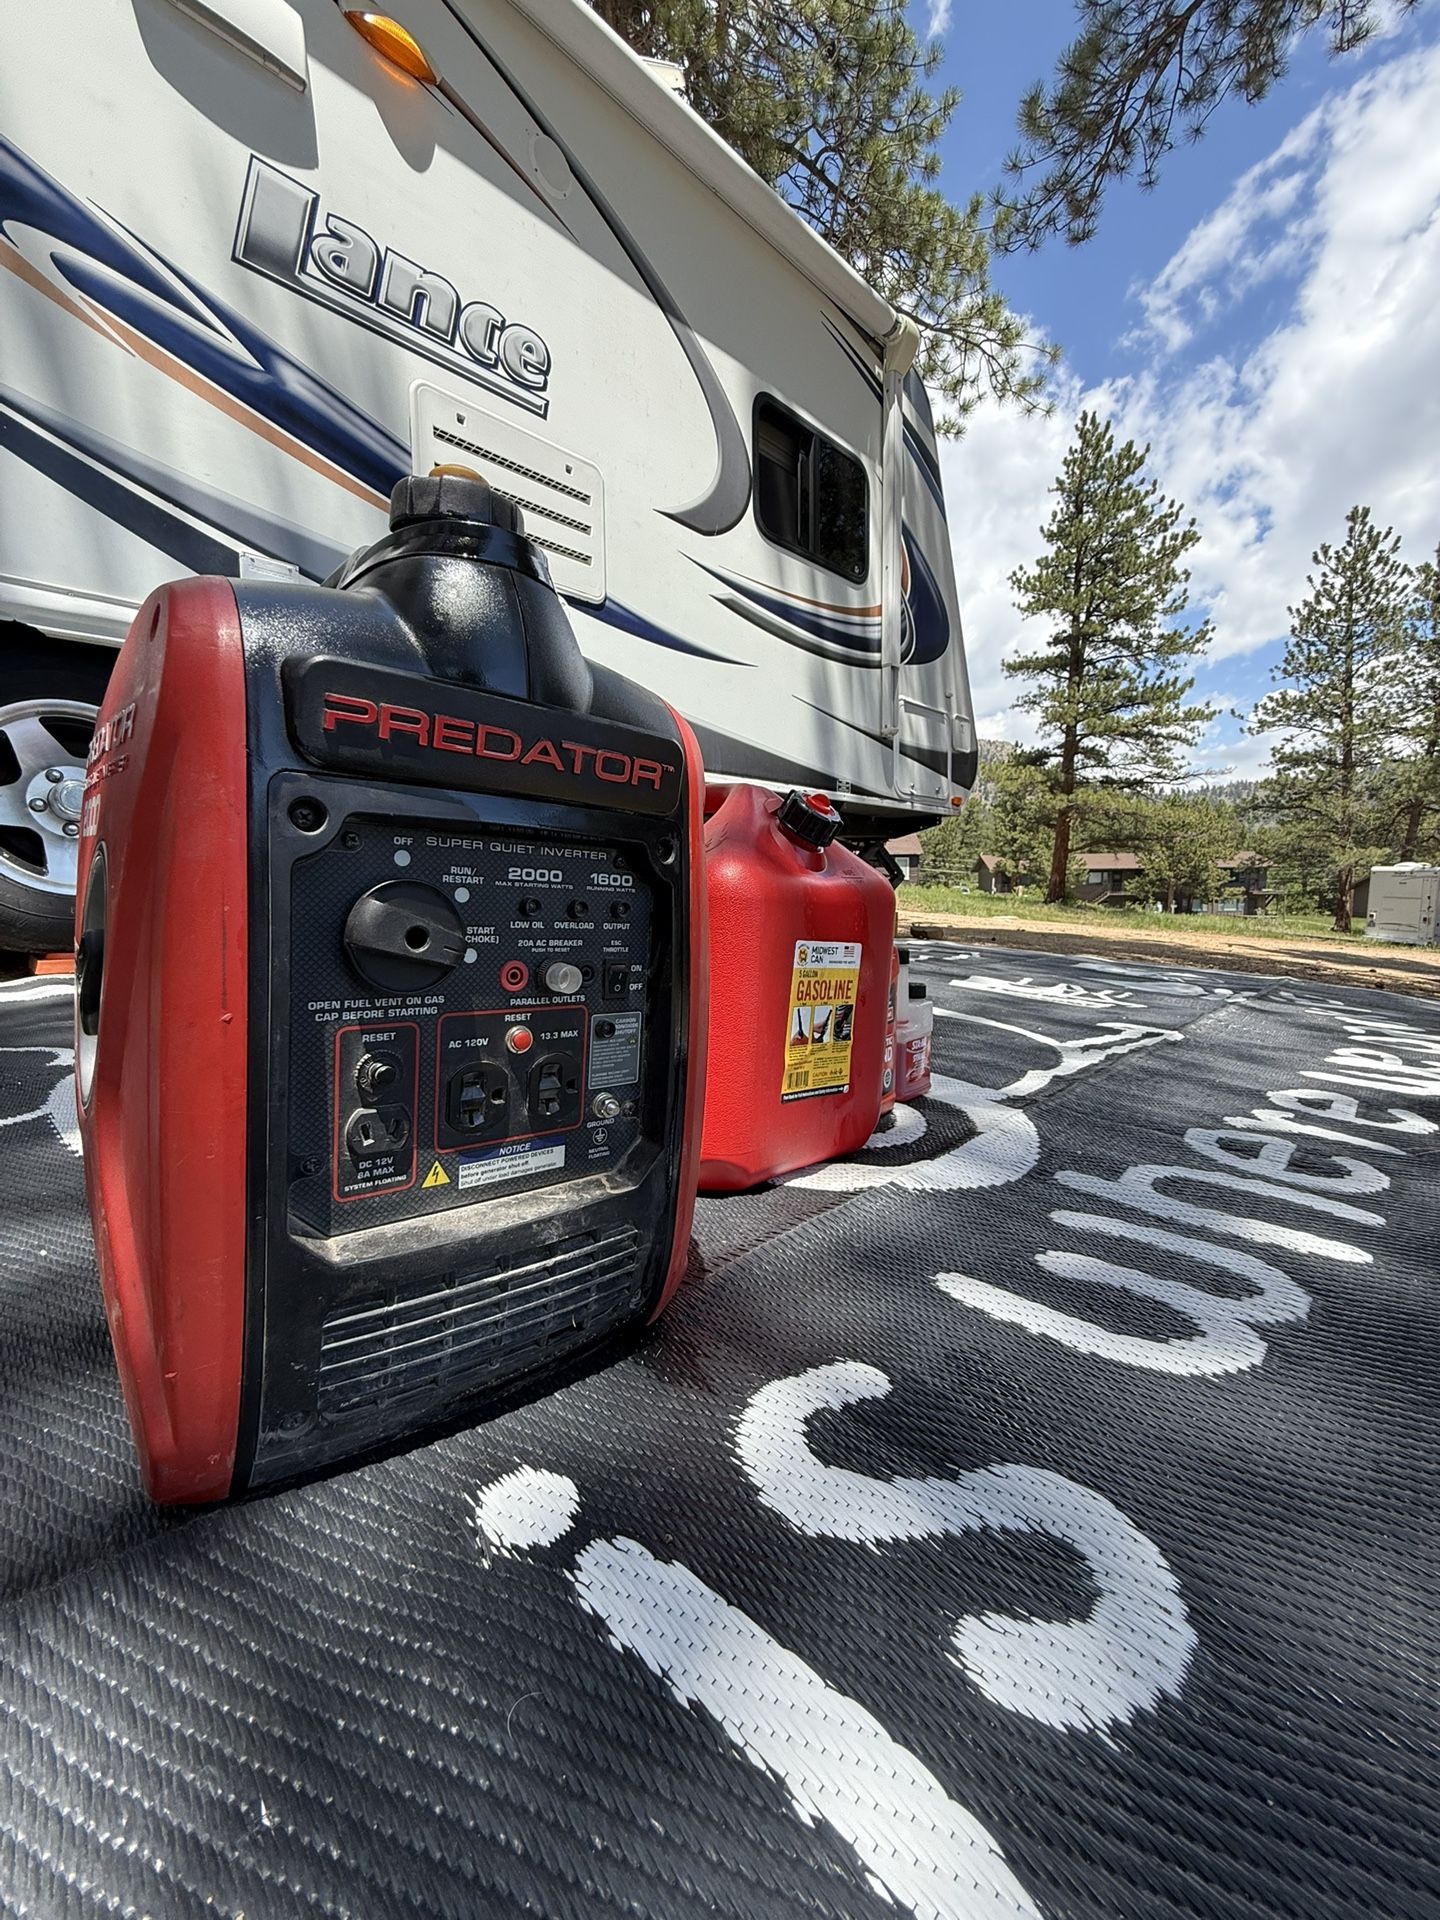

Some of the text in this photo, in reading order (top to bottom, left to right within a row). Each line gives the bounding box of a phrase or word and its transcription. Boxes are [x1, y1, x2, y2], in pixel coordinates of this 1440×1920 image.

[323, 692, 663, 790] PREDATOR
[393, 836, 414, 846] OFF
[425, 836, 607, 861] SUPER QUIET INVERTER
[450, 865, 477, 876] RUN/
[508, 867, 563, 882] 2000
[442, 875, 484, 885] RESTART
[590, 873, 633, 887] 1600
[466, 926, 496, 934] START
[510, 921, 545, 929] LOW OIL
[554, 921, 594, 930] OVERLOAD
[603, 922, 630, 931] OUTPUT
[464, 935, 499, 944] CHOKE)
[517, 939, 583, 948] 20A AC BREAKER
[812, 945, 839, 955] MIDWEST
[810, 954, 824, 963] CAN
[629, 983, 643, 991] OFF
[796, 979, 853, 1002] GASOLINE
[308, 995, 445, 1010] OPEN FUEL VENT ON GAS
[510, 994, 586, 1006] PARALLEL OUTLETS
[315, 1006, 438, 1022] CAP BEFORE STARTING
[504, 1013, 532, 1022] RESET
[362, 1032, 397, 1043] RESET
[540, 1030, 579, 1040] 13.3 MAX
[448, 1038, 489, 1049] AC 120V
[586, 1117, 615, 1128] GROUND
[499, 1142, 532, 1156] NOTICE
[358, 1156, 394, 1169] DC 12V
[460, 1148, 554, 1172] DISCONNECT POWERED DEVICES
[357, 1166, 395, 1180] 8A MAX
[460, 1171, 479, 1180] before
[480, 1165, 507, 1176] generator
[508, 1161, 521, 1170] shut
[344, 1174, 407, 1192] SYSTEM FLOATING
[470, 1360, 1198, 1919] is
[929, 1086, 1439, 1379] where
